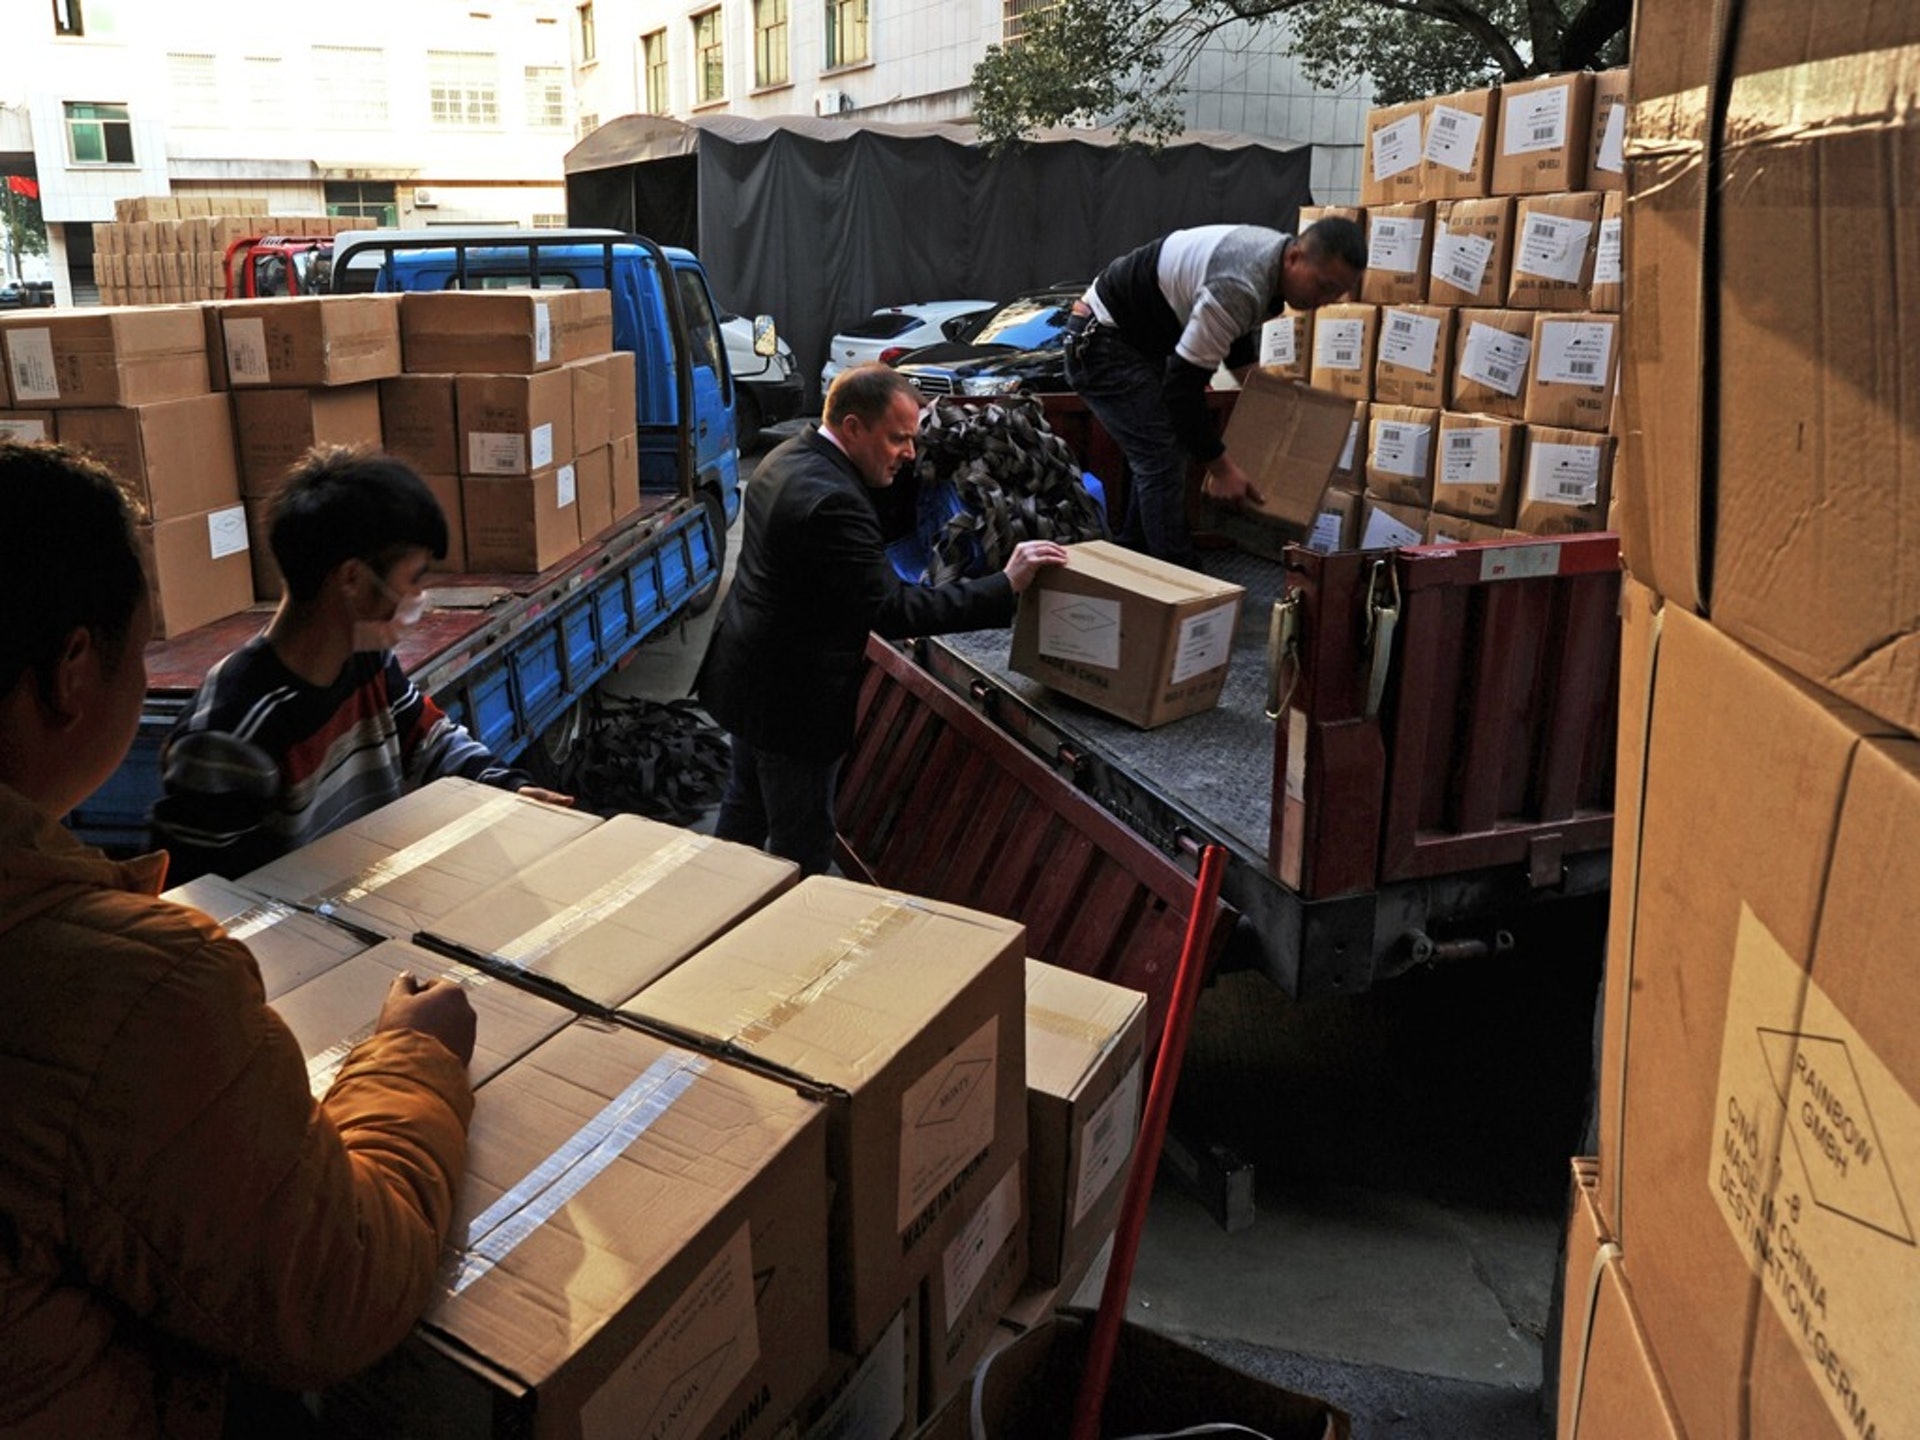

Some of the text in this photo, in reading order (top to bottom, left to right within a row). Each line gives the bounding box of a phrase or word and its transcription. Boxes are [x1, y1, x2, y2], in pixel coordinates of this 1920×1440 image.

[1794, 1052, 1872, 1166] RAINBOW
[1801, 1101, 1848, 1178] GMBH
[1723, 1128, 1826, 1321] MADE IN CHINA
